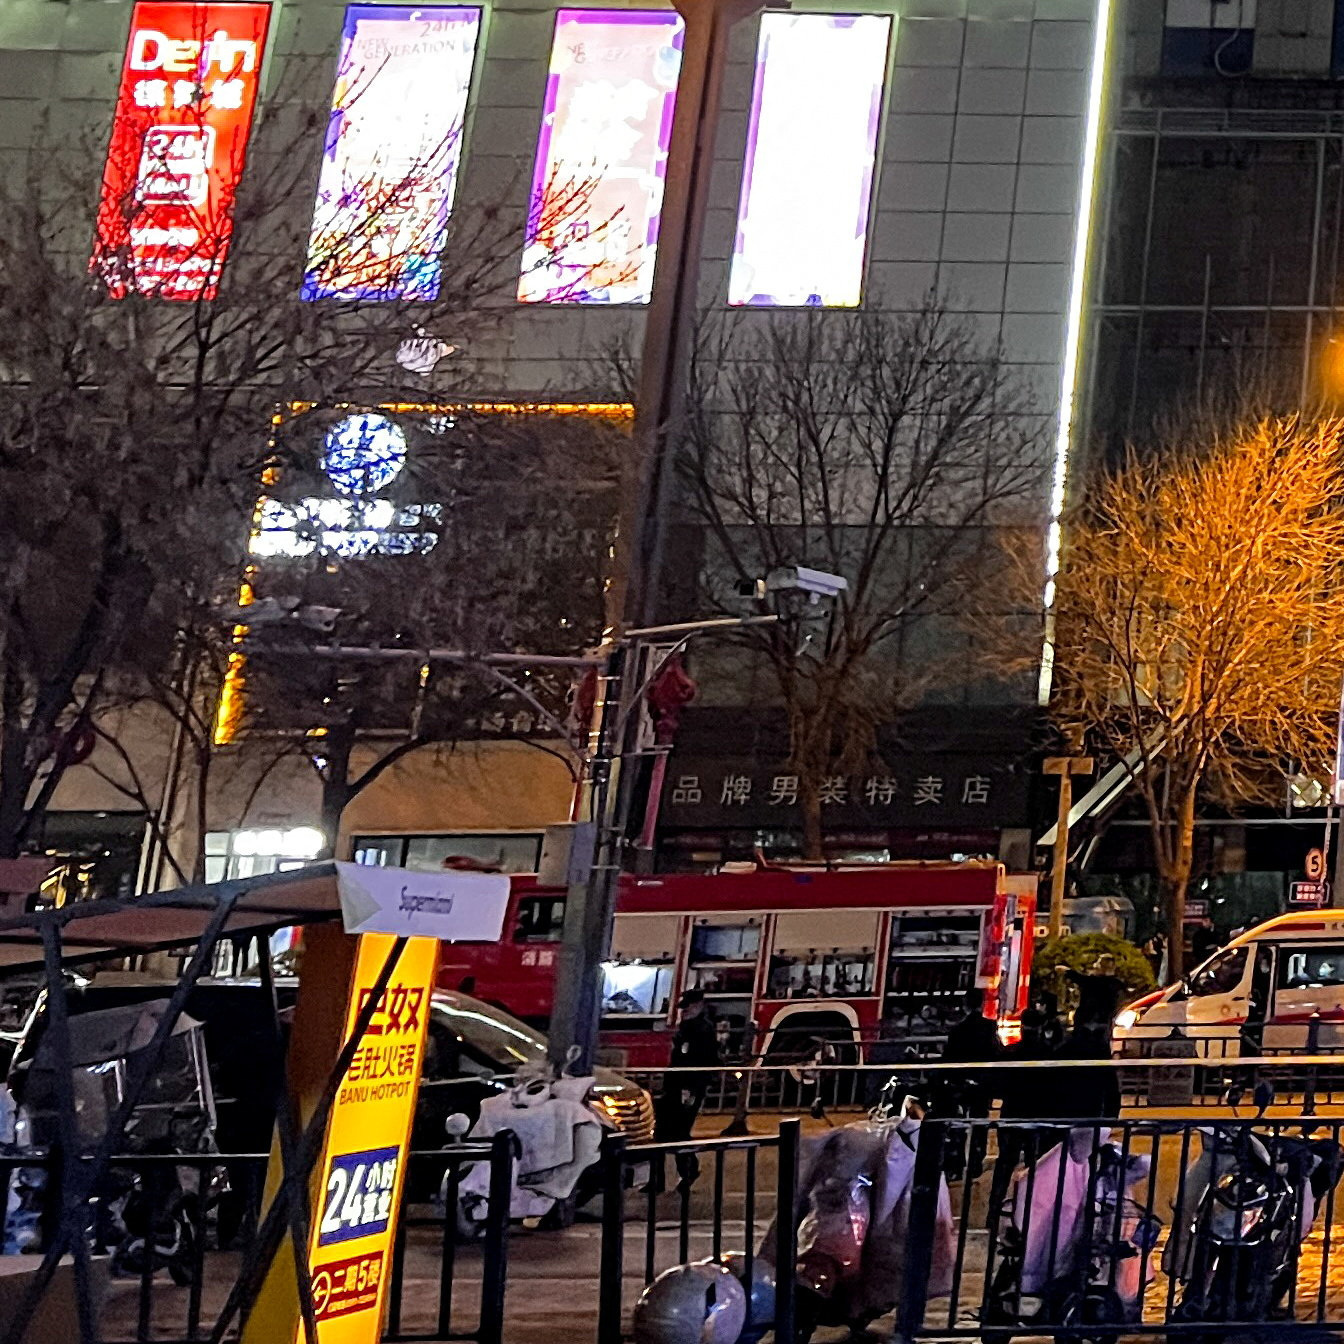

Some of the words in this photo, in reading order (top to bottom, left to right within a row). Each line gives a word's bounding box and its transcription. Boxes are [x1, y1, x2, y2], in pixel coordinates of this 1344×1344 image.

[671, 774, 994, 807] 品牌男装特卖店
[1310, 855, 1320, 873] 5
[347, 1043, 417, 1083] 毛肚火锅
[339, 1085, 368, 1106] BANU
[370, 1080, 411, 1102] HOTPOT
[365, 1158, 398, 1191] 小时
[320, 1163, 366, 1234] 24
